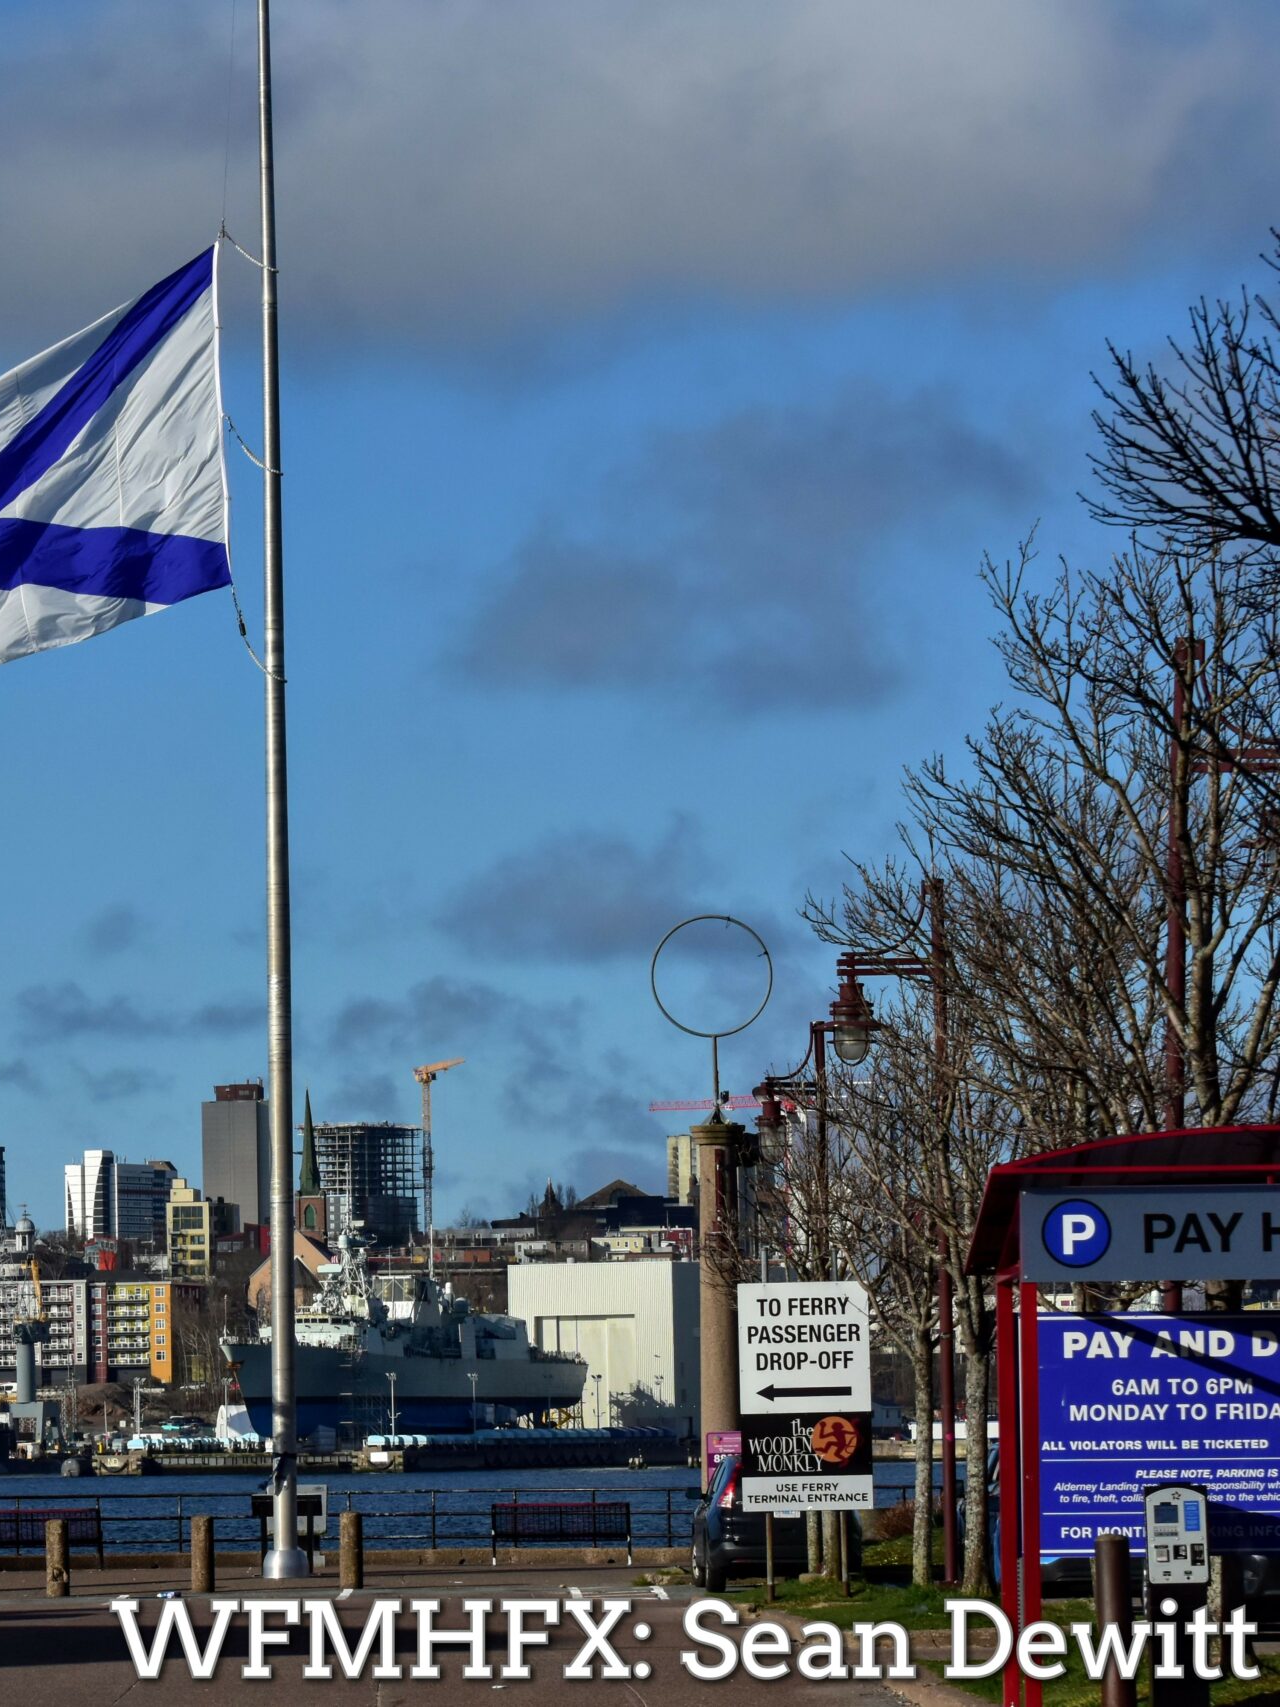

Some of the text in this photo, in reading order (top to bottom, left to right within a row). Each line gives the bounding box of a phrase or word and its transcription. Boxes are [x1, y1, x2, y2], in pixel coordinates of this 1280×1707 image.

[1062, 1214, 1096, 1255] P
[1143, 1212, 1244, 1254] PAY
[756, 1296, 849, 1317] TO FERRY
[747, 1323, 861, 1345] PASSENGER
[1063, 1330, 1136, 1360] PAY
[1150, 1329, 1236, 1359] AND
[756, 1350, 854, 1371] DROP-OFF
[1111, 1377, 1254, 1396] 6AM TO 6PM
[1069, 1403, 1169, 1422] MONDAY
[1176, 1403, 1208, 1421] TO
[790, 1418, 814, 1436] the
[748, 1436, 813, 1455] WOODEN
[1041, 1439, 1269, 1451] ALL VIOLATORS WILL BE TICKETED
[757, 1454, 825, 1473] MONKEY
[1135, 1468, 1279, 1480] PLEASE NOTE, PARKING IS
[776, 1482, 839, 1493] USE FERRY
[1054, 1482, 1139, 1493] Alderney Landing
[748, 1493, 869, 1504] TERMINAL ENTRANCE
[1059, 1495, 1070, 1503] to
[1072, 1494, 1091, 1504] fire,
[1093, 1494, 1119, 1504] theft,
[1226, 1493, 1237, 1502] to
[1238, 1492, 1254, 1502] the
[1061, 1526, 1092, 1539] FOR
